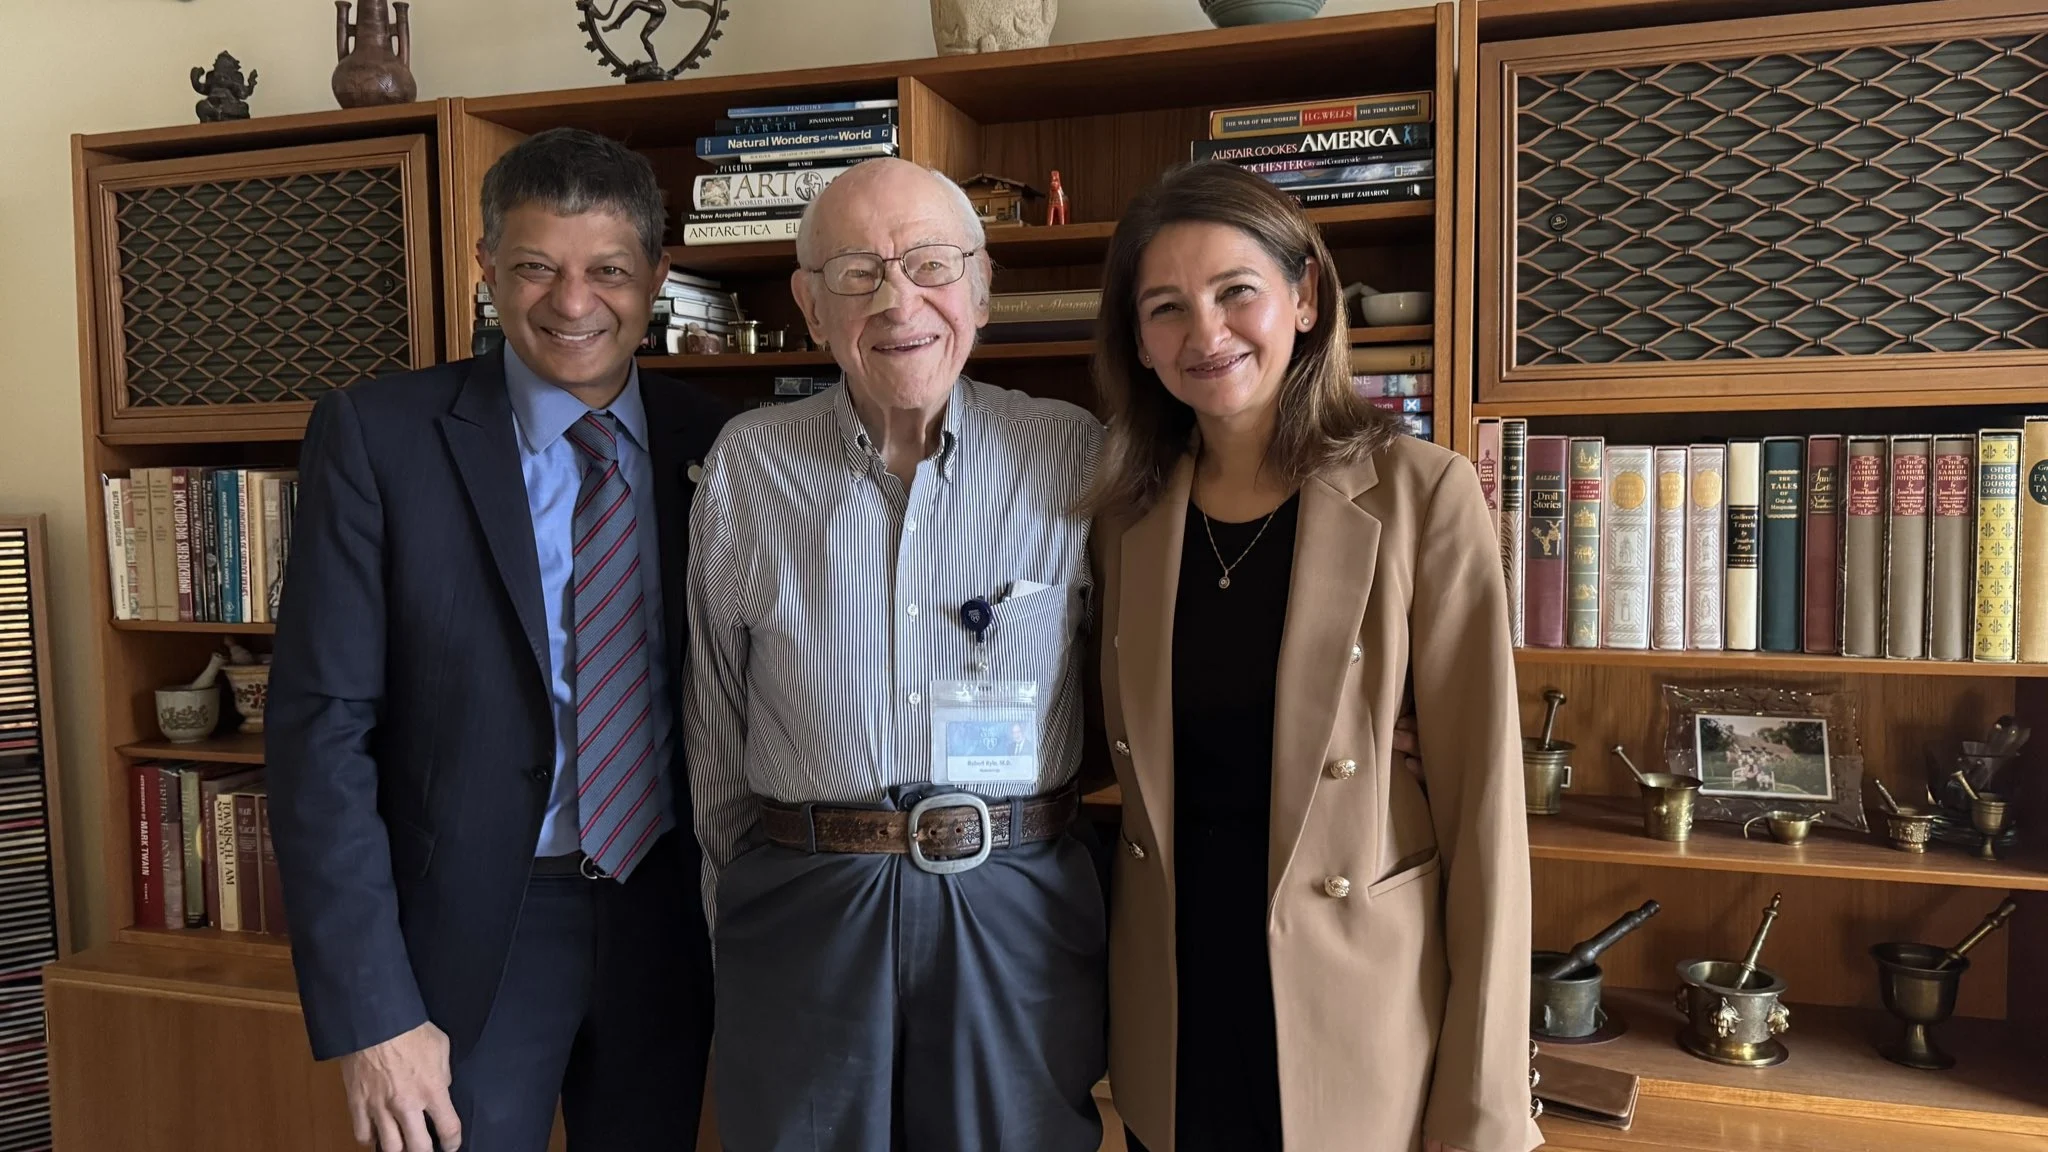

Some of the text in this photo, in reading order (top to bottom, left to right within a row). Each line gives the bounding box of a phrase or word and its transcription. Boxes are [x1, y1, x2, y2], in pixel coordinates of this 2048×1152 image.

[1388, 104, 1416, 112] MACHINE
[808, 115, 854, 125] JONATHAN WEINER
[728, 136, 769, 149] Natural
[771, 134, 820, 147] Wonders
[838, 129, 872, 141] World
[1211, 147, 1254, 161] ALISTAIR
[1298, 127, 1402, 153] AMERICA
[1240, 159, 1303, 173] OCHESTER
[1303, 158, 1315, 167] City
[1315, 157, 1327, 166] and
[734, 171, 797, 200] ART
[765, 197, 794, 205] HISTORY
[1306, 192, 1329, 202] EDITED
[1331, 191, 1340, 201] BY
[1341, 190, 1354, 200] IRIT
[1356, 189, 1390, 198] ZAHARONI
[714, 211, 742, 220] Acropolis
[689, 224, 771, 239] ANTARCTICA
[2033, 474, 2047, 482] FA
[191, 477, 201, 518] SHERLOCK
[1537, 491, 1558, 501] Droll
[2034, 485, 2047, 493] TA
[1532, 500, 1562, 510] Stories
[112, 490, 122, 547] BATTALION SURGEON
[173, 490, 188, 540] ENCYCLOPEDIA
[194, 520, 203, 553] HOLMES
[177, 541, 191, 594] SHERLOCKIANA
[140, 820, 149, 847] MARK
[141, 847, 150, 876] TWAIN
[225, 867, 235, 885] AM
